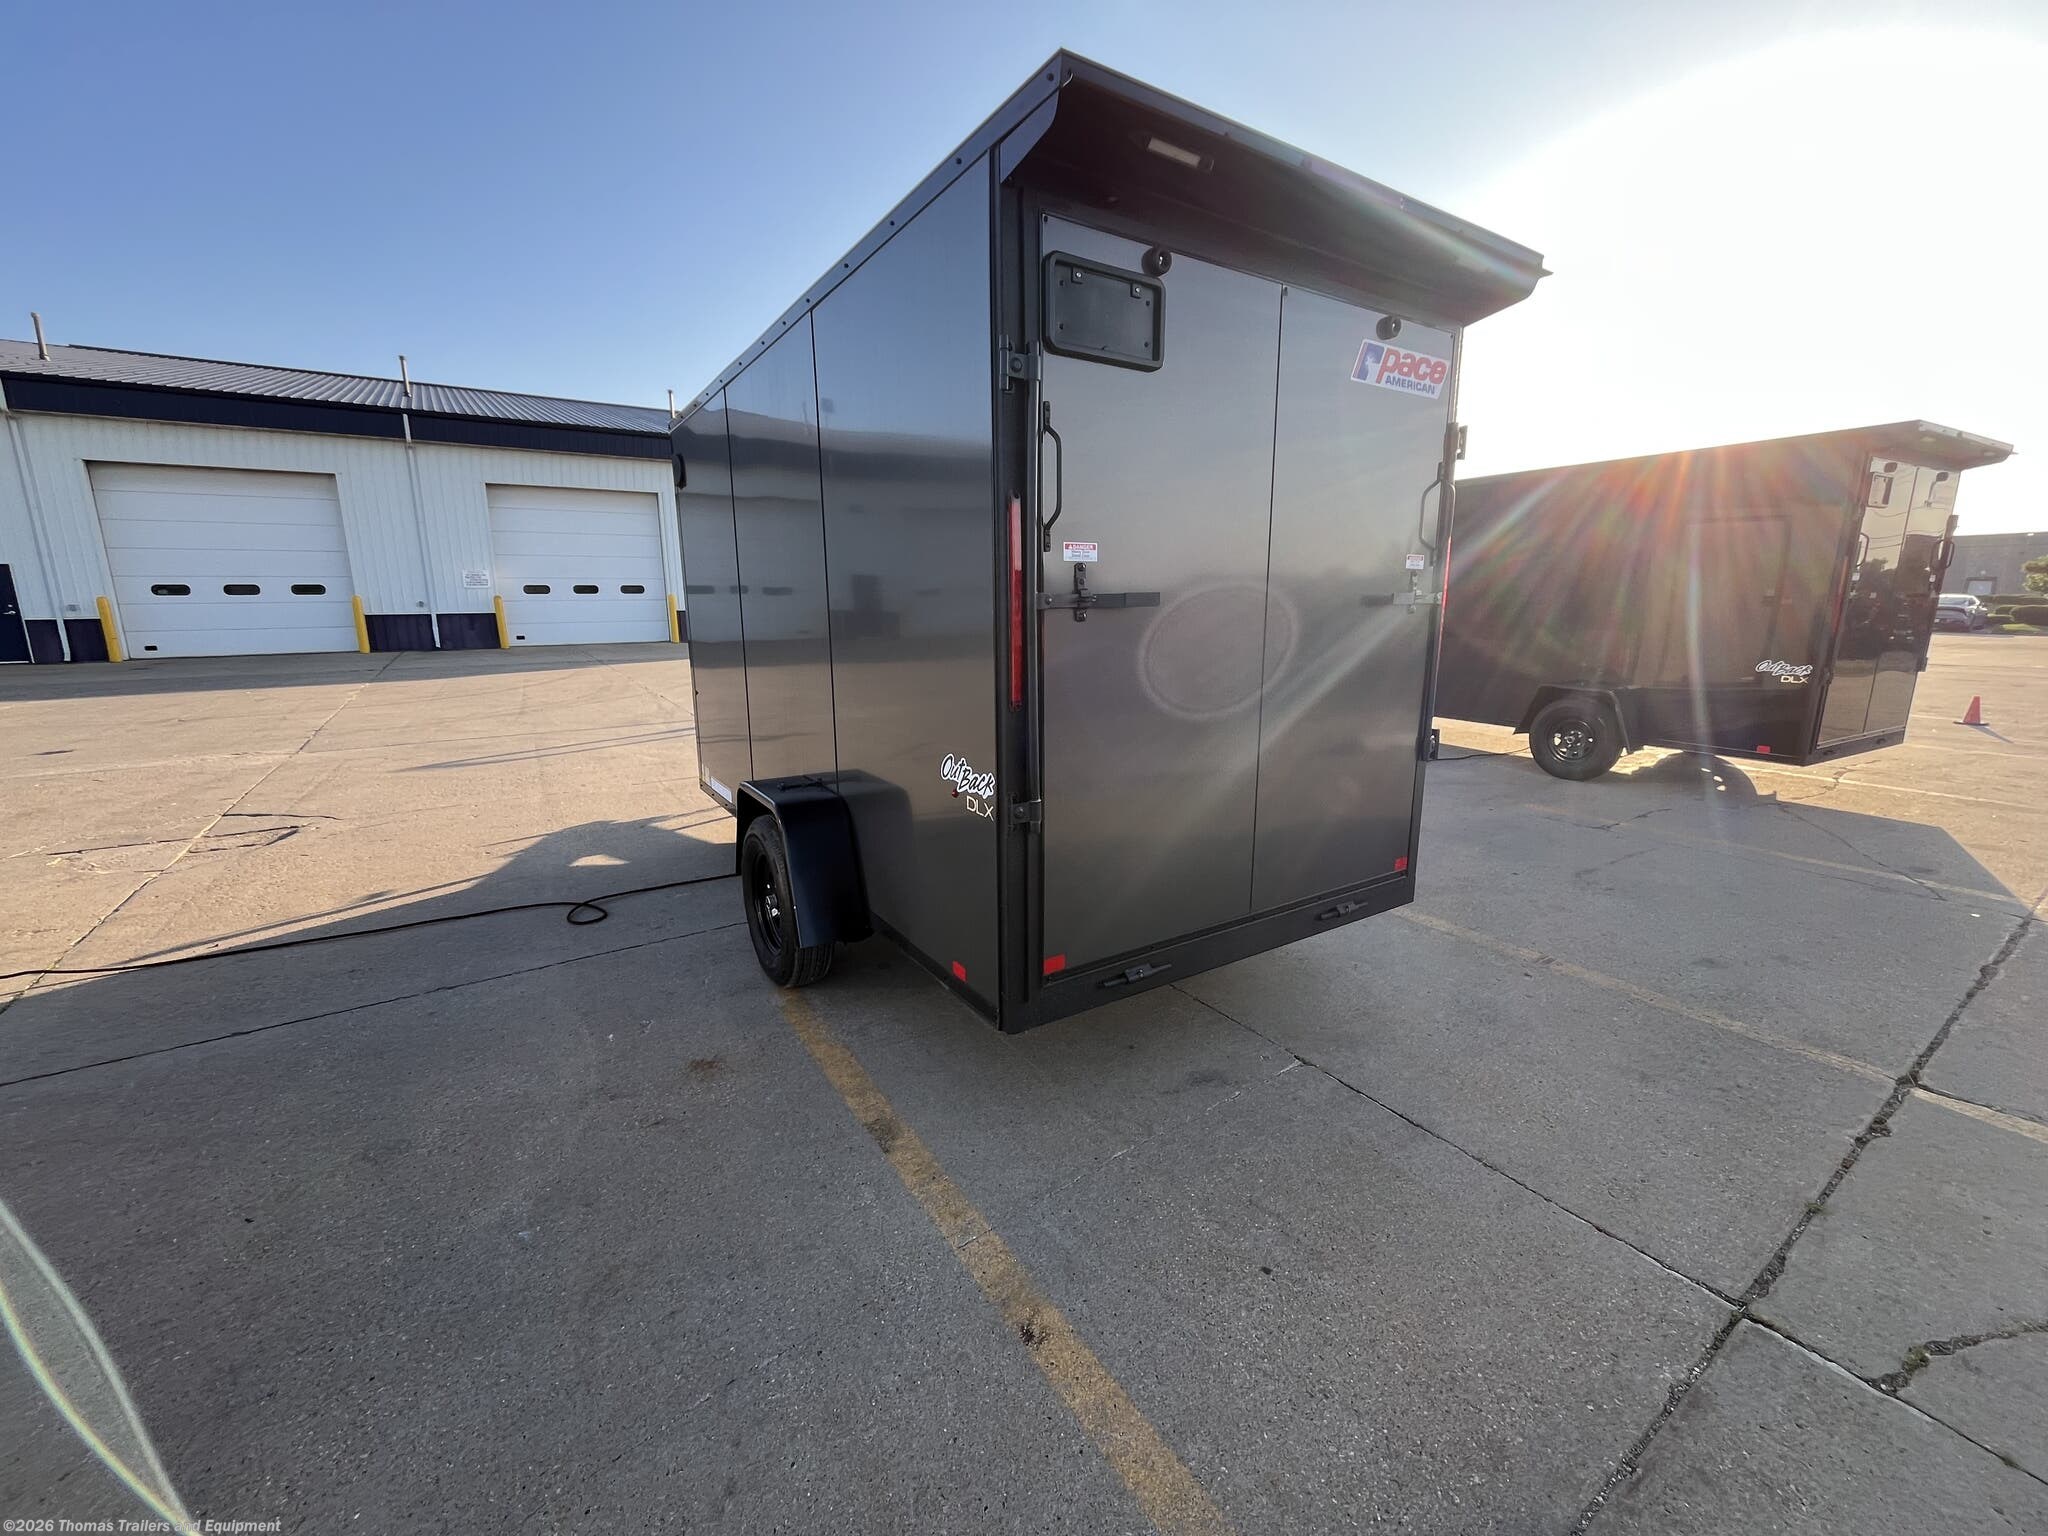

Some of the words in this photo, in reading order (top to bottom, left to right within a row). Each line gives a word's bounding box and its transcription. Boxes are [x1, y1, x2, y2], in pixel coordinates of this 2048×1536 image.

[1376, 347, 1448, 384] pace
[1385, 375, 1435, 394] AMERICAN
[1780, 675, 1808, 684] DLX
[966, 795, 994, 821] DLX
